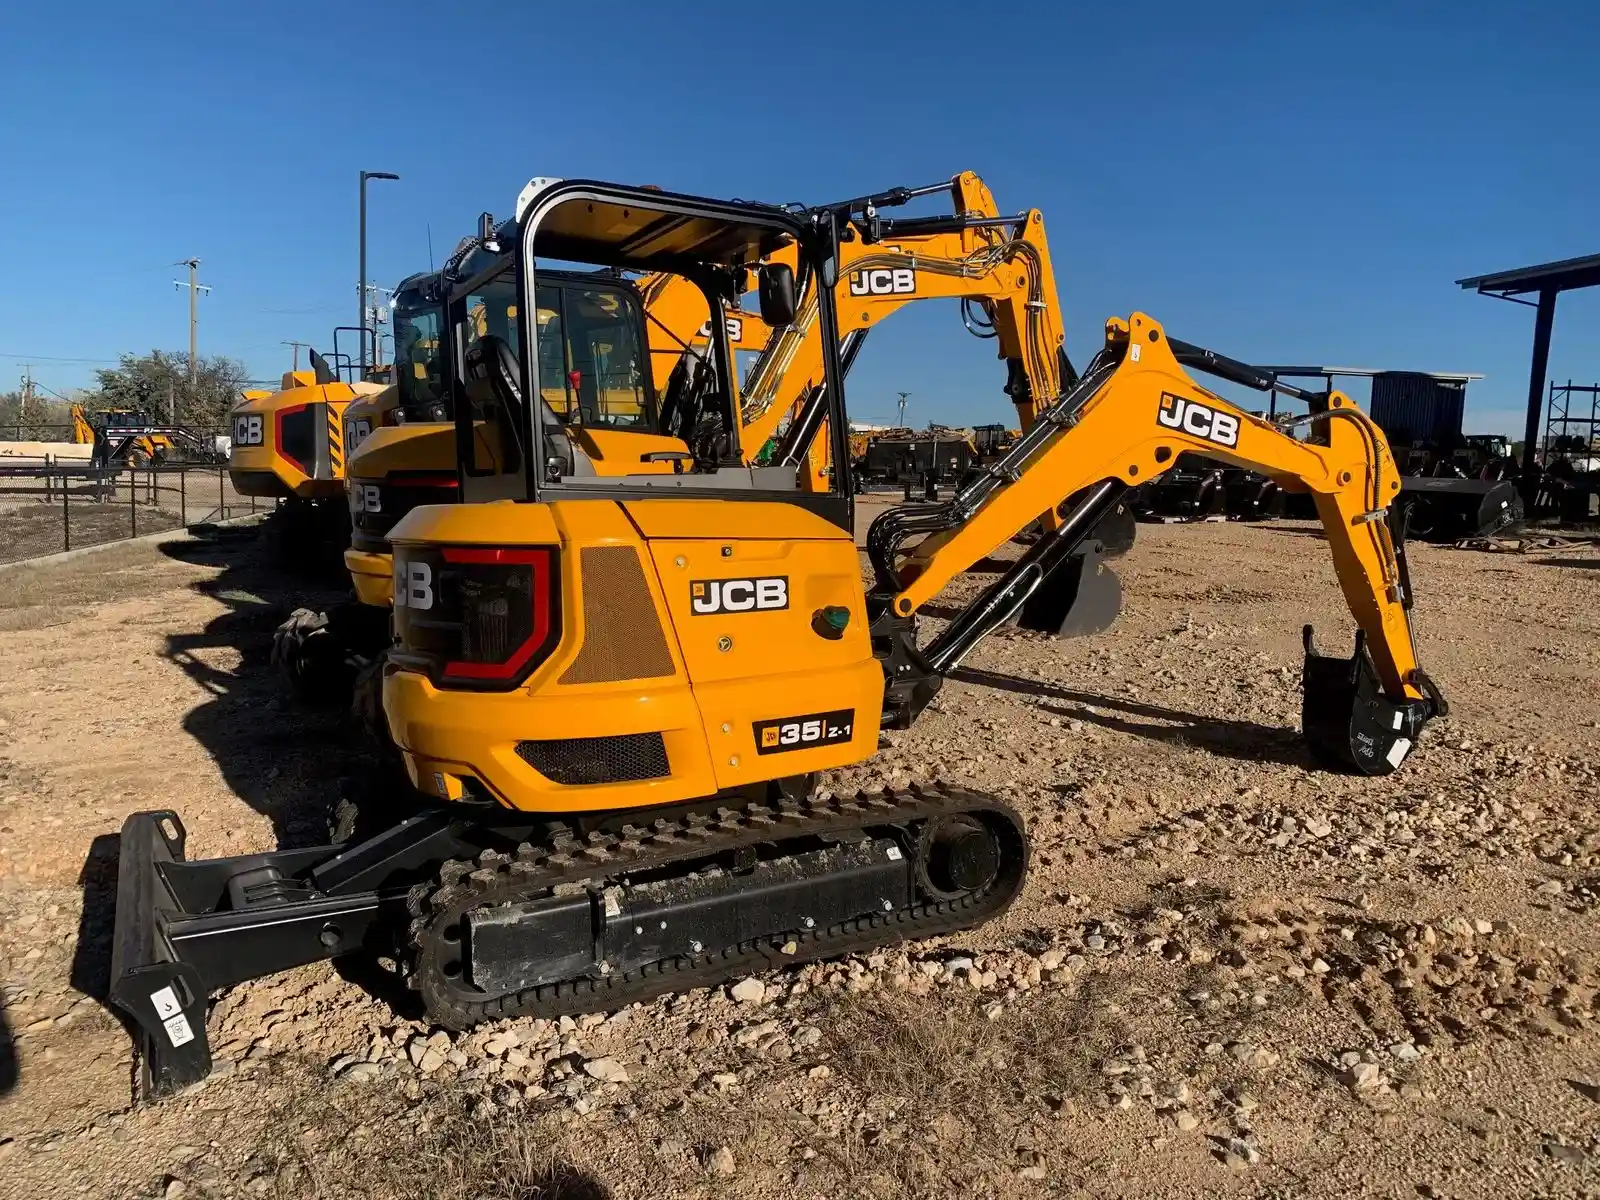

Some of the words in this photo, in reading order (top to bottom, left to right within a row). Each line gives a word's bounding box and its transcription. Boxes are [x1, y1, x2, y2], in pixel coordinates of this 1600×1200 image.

[851, 269, 914, 295] JCB
[1159, 399, 1239, 446] JCB
[693, 578, 788, 613] JCB
[780, 720, 821, 744] 35
[828, 724, 851, 738] Z-1
